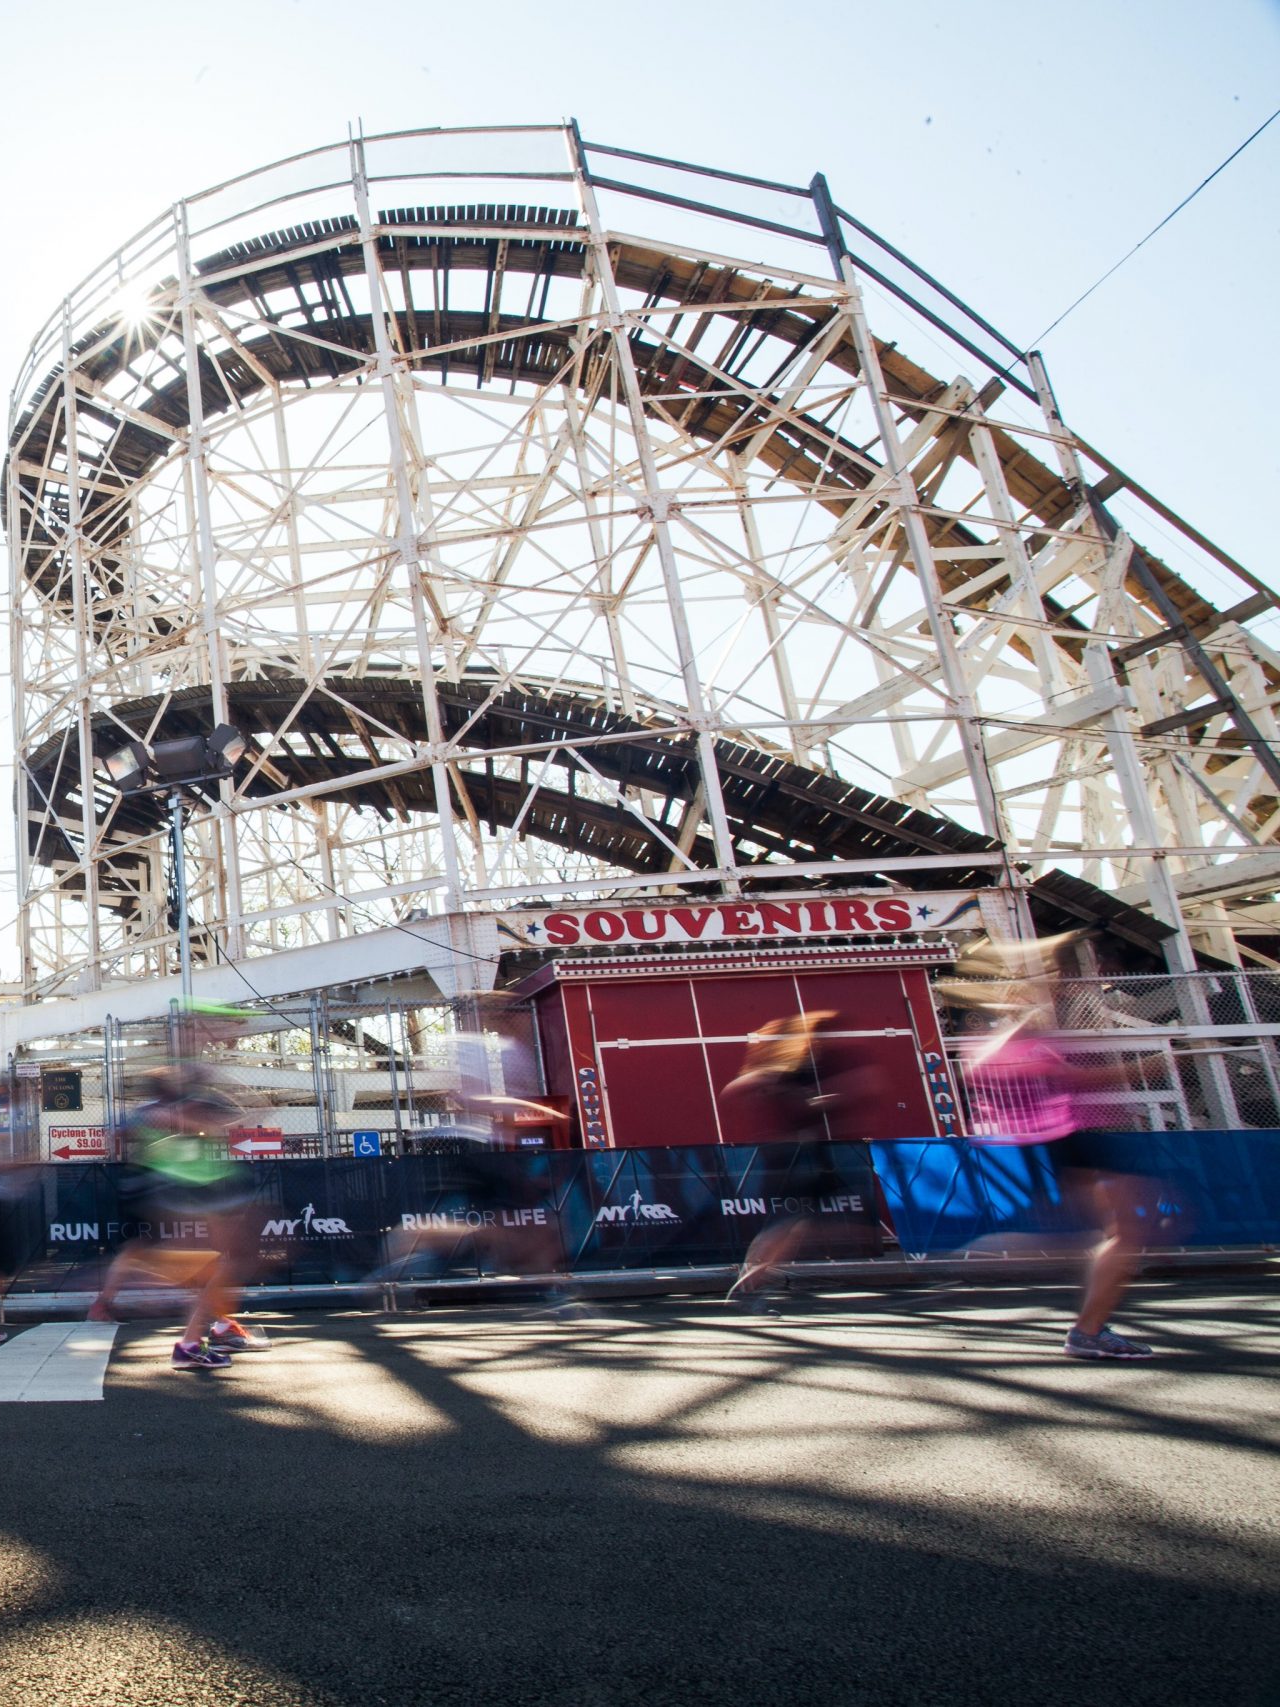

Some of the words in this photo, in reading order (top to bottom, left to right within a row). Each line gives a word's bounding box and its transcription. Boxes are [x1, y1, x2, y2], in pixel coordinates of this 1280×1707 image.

[543, 900, 912, 945] SOUVENIRS
[924, 1052, 959, 1137] PHOT
[578, 1067, 606, 1148] SOUVEN
[51, 1128, 87, 1139] Cyclone
[76, 1138, 102, 1149] $9.00
[720, 1198, 766, 1216] RUN
[770, 1196, 815, 1215] FOR
[820, 1194, 864, 1213] LIFE
[50, 1223, 98, 1241] RUN
[107, 1221, 152, 1240] FOR
[160, 1220, 209, 1239] LIFE
[401, 1213, 448, 1231] RUN
[452, 1210, 496, 1230] FOR
[502, 1208, 547, 1227] LIFE
